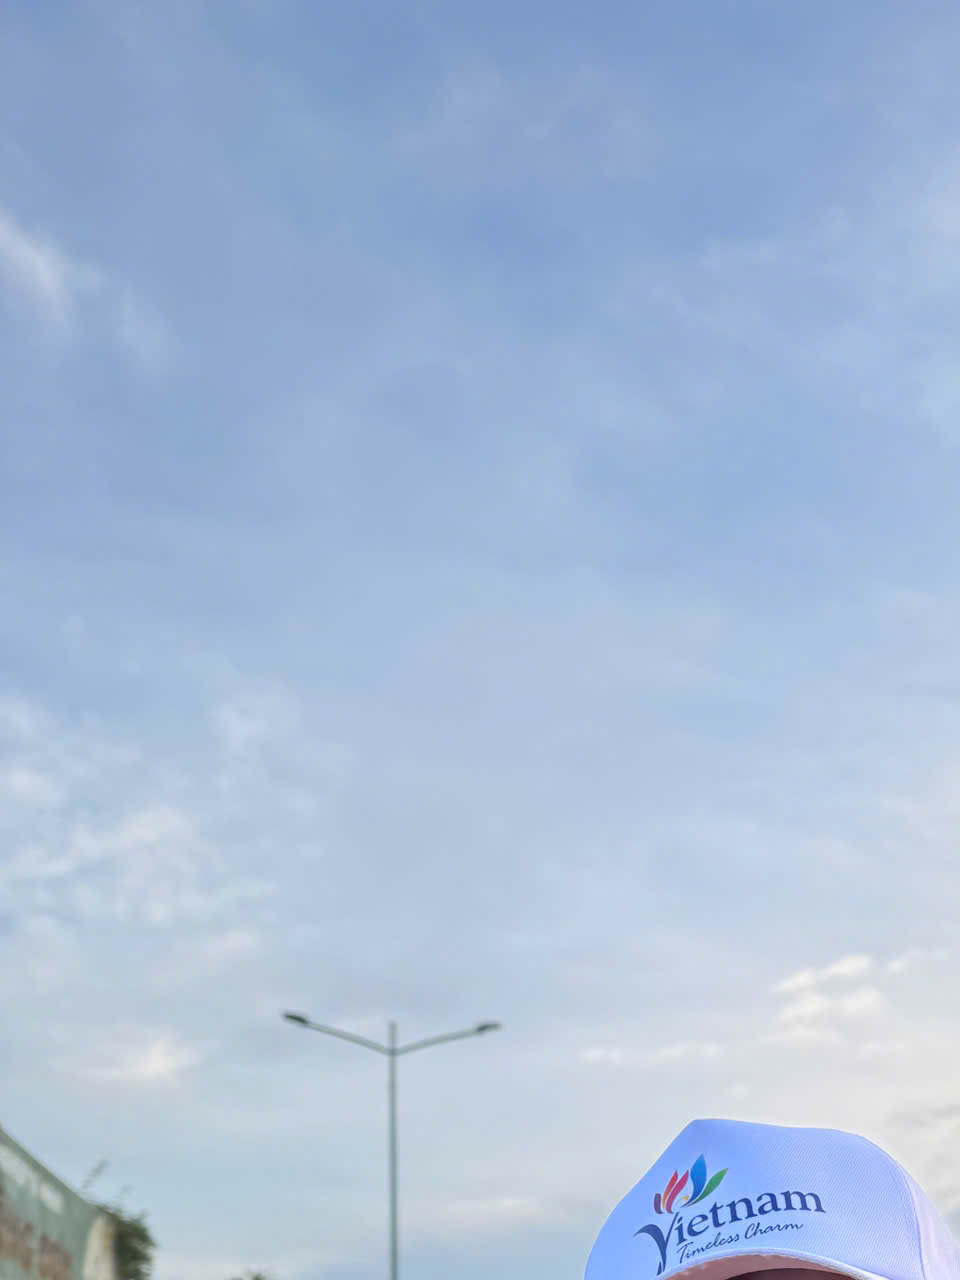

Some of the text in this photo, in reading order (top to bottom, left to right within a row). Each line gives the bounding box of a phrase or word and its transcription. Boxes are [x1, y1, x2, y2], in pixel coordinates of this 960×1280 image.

[633, 1190, 826, 1275] Vietnam
[677, 1221, 804, 1264] Timeless Charm
